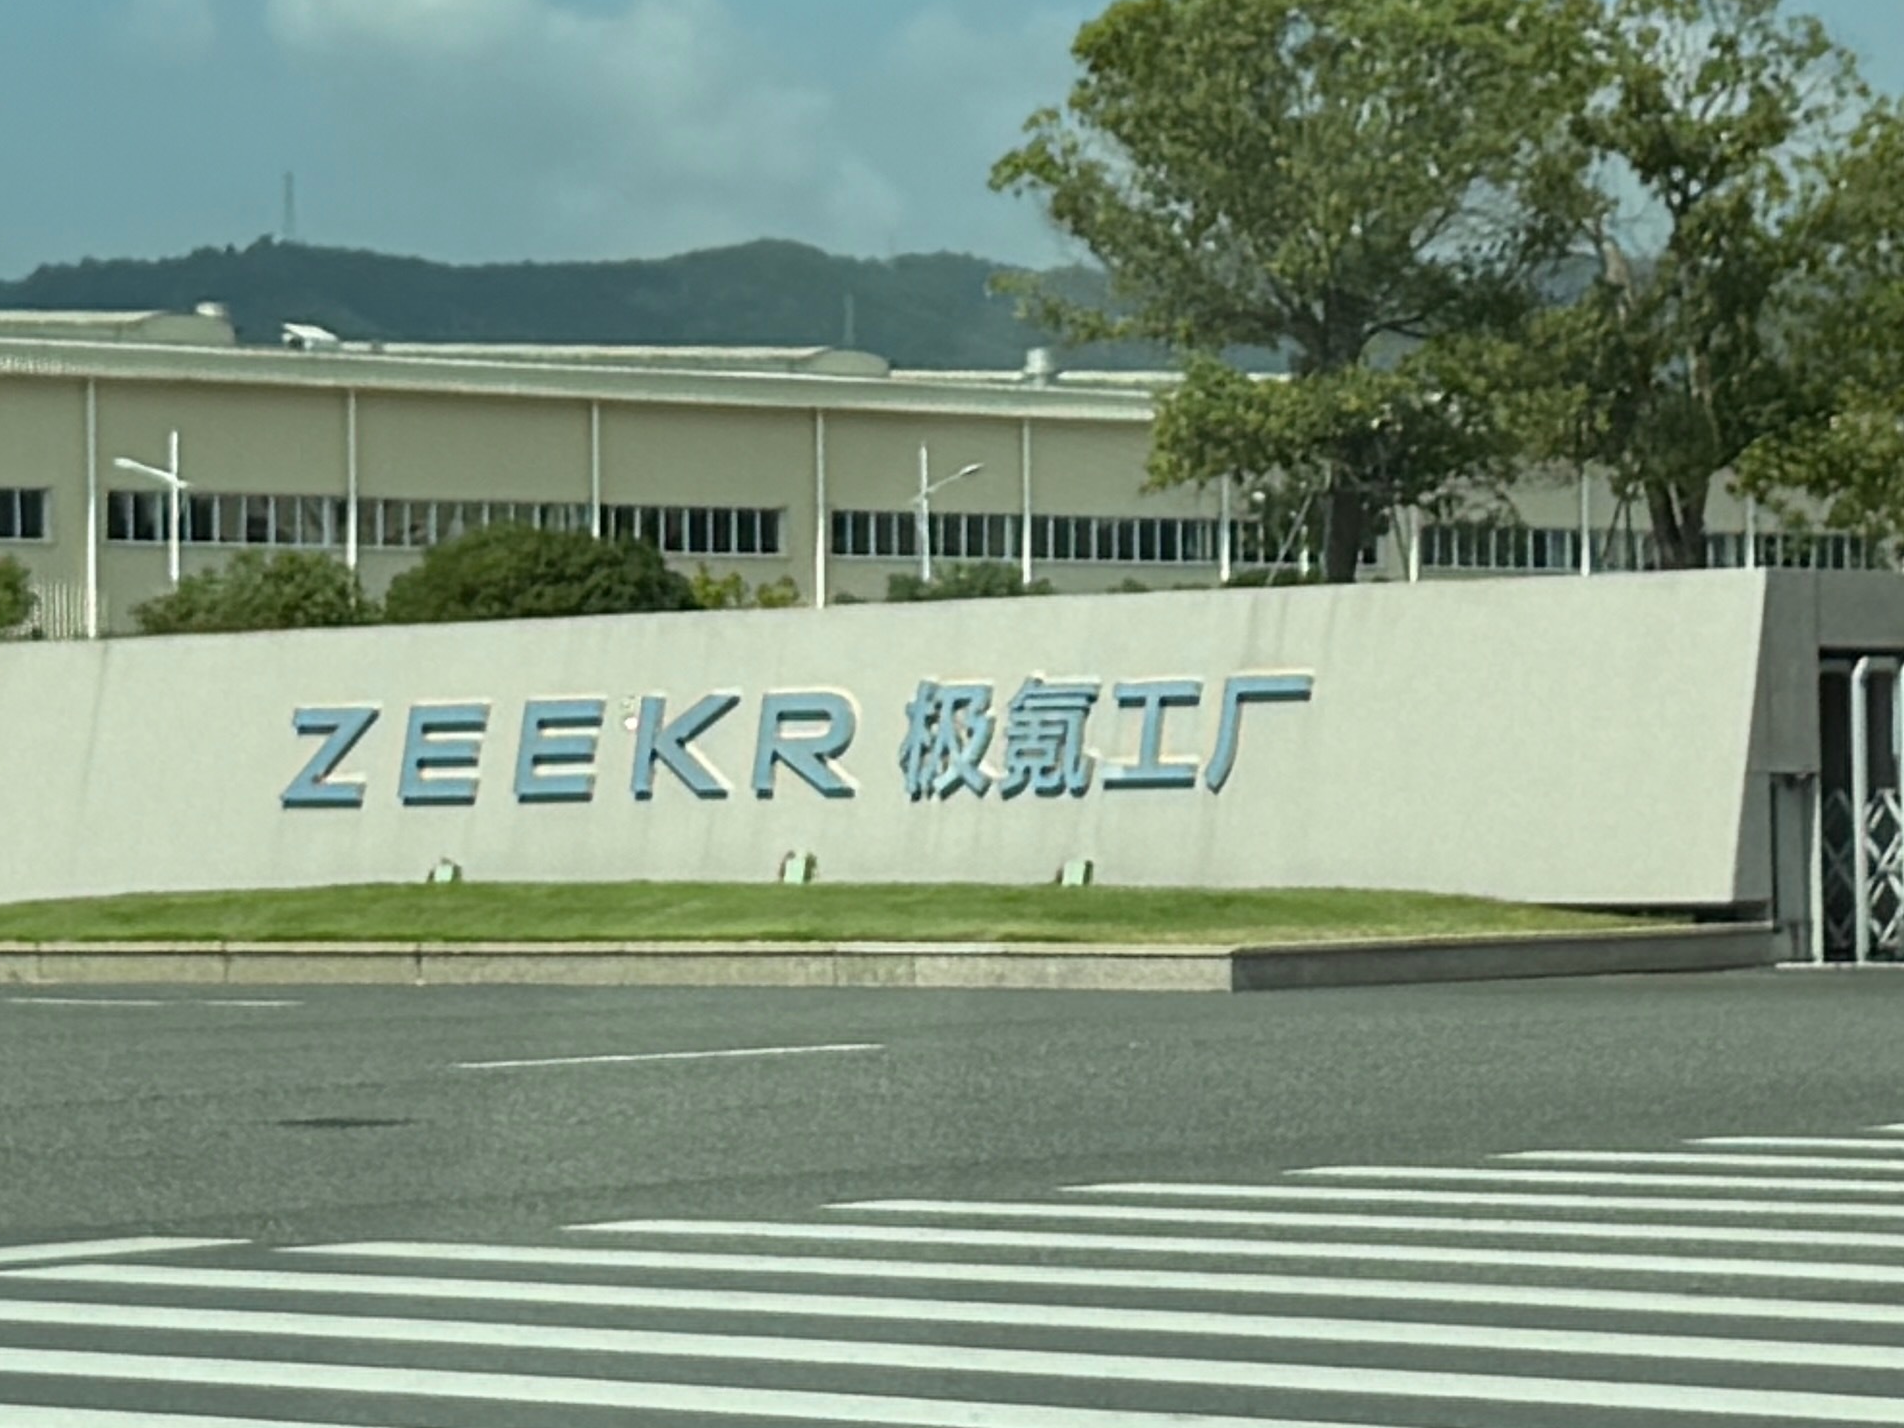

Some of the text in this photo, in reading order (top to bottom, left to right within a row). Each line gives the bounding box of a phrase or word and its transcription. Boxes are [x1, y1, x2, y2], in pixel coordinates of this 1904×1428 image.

[282, 670, 1314, 809] ZEEKR 极氪工厂
